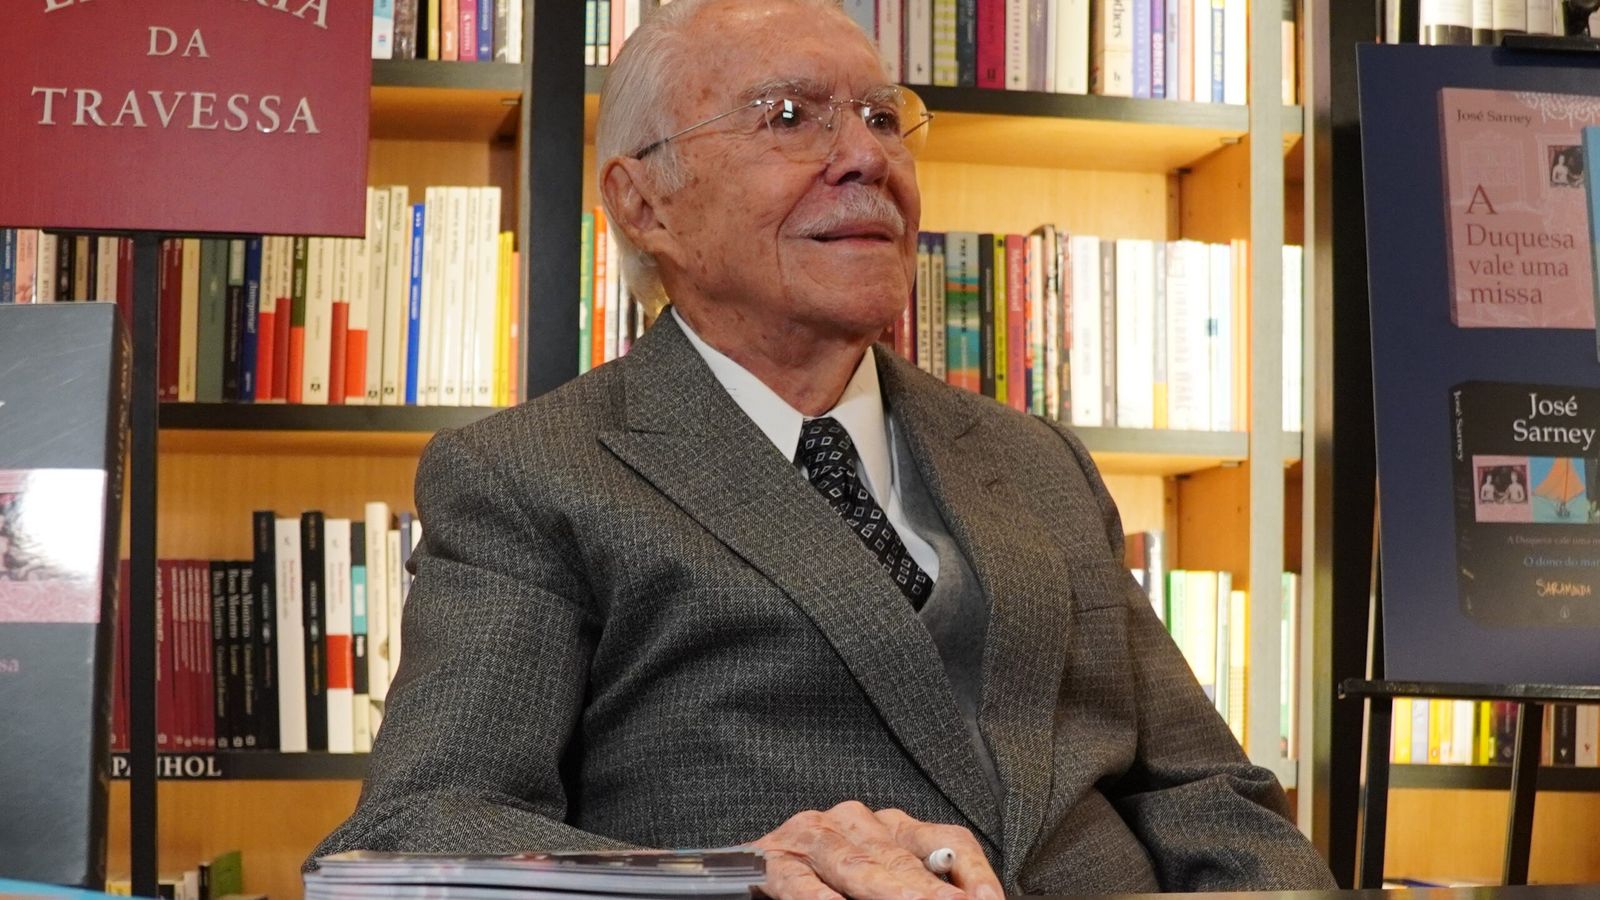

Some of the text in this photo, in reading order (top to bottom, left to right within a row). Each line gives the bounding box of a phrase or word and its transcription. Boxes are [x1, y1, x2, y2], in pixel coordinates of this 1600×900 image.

[1113, 0, 1125, 38] thers
[146, 26, 209, 58] DA
[31, 86, 320, 134] TRAVESSA
[1456, 108, 1532, 127] José Sarney
[1465, 184, 1498, 215] A
[1466, 223, 1575, 255] Duquesa
[1468, 254, 1569, 278] vale uma
[1470, 280, 1543, 305] missa
[1528, 392, 1578, 419] José
[1512, 419, 1596, 451] Sarney
[229, 594, 240, 638] Montero
[242, 594, 253, 638] Montero
[112, 755, 222, 777] PHOL
